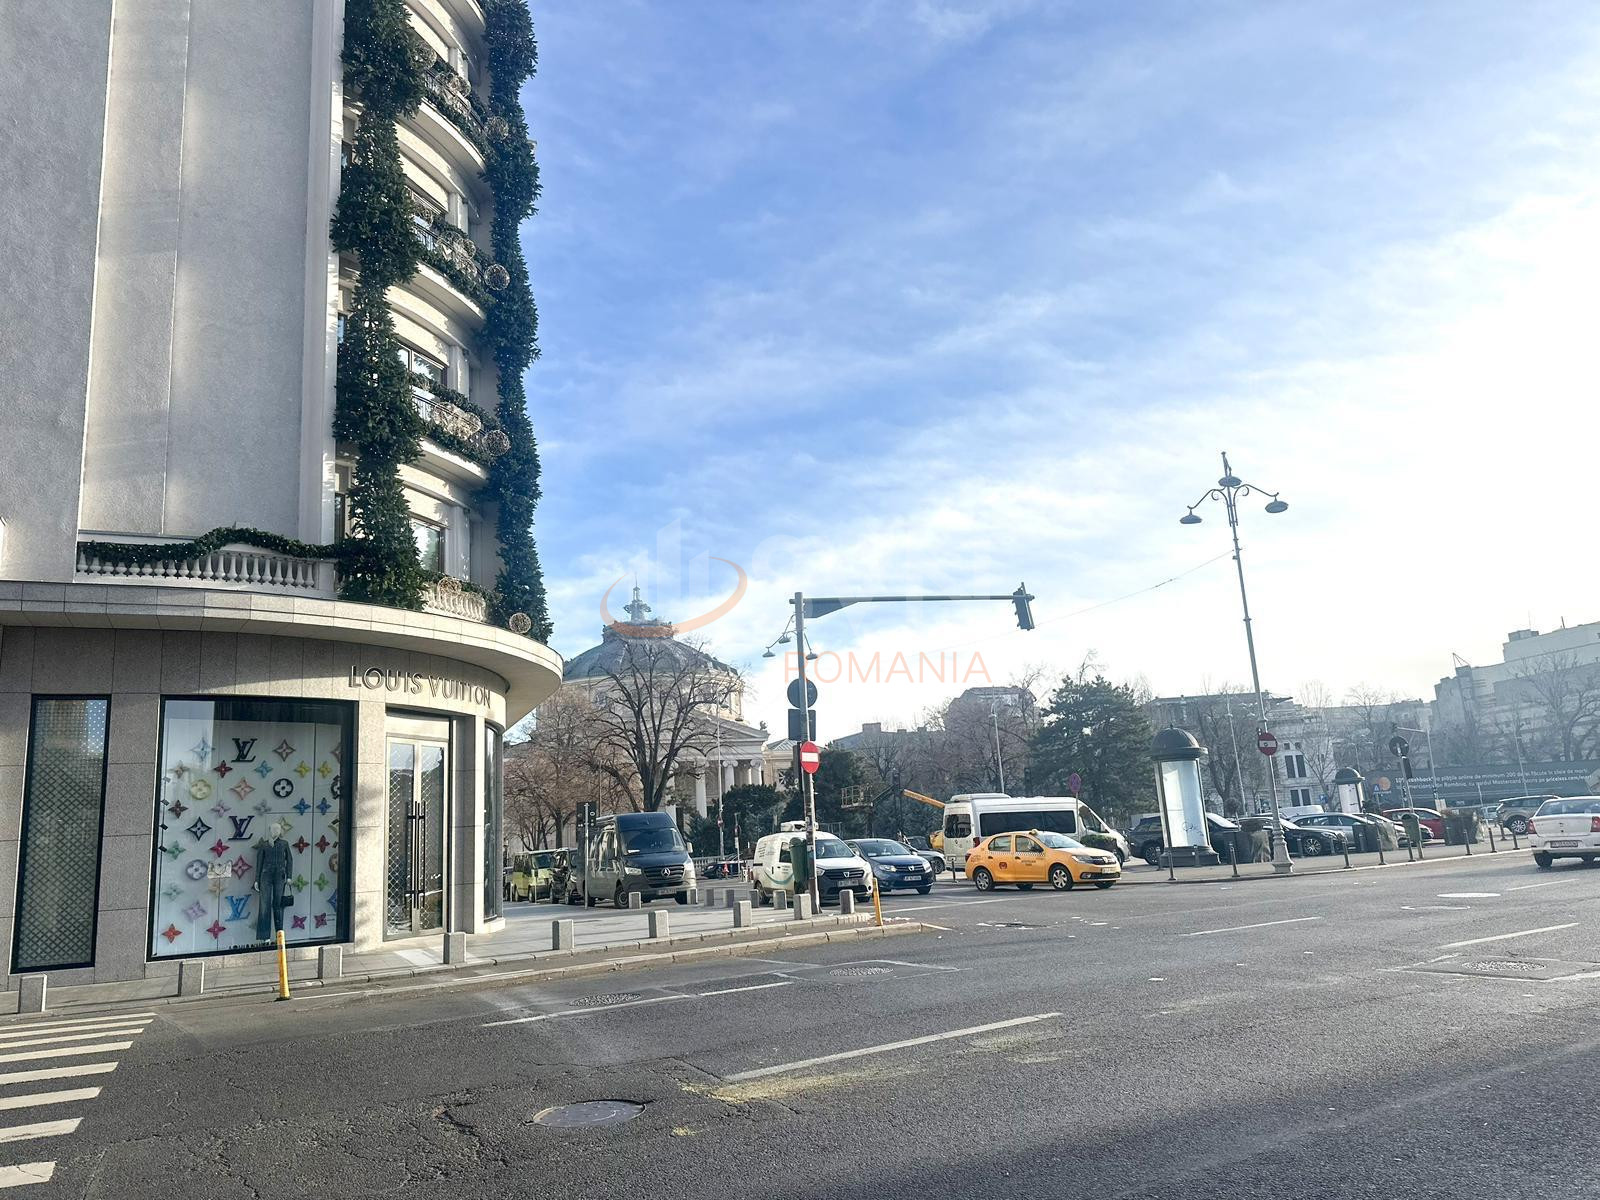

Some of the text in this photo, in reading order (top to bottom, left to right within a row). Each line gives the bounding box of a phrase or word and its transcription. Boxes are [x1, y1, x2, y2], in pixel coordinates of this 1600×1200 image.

[348, 665, 491, 708] LOUIS VUITTON
[231, 738, 258, 763] LV
[228, 815, 255, 840] LV
[225, 894, 251, 922] LV
